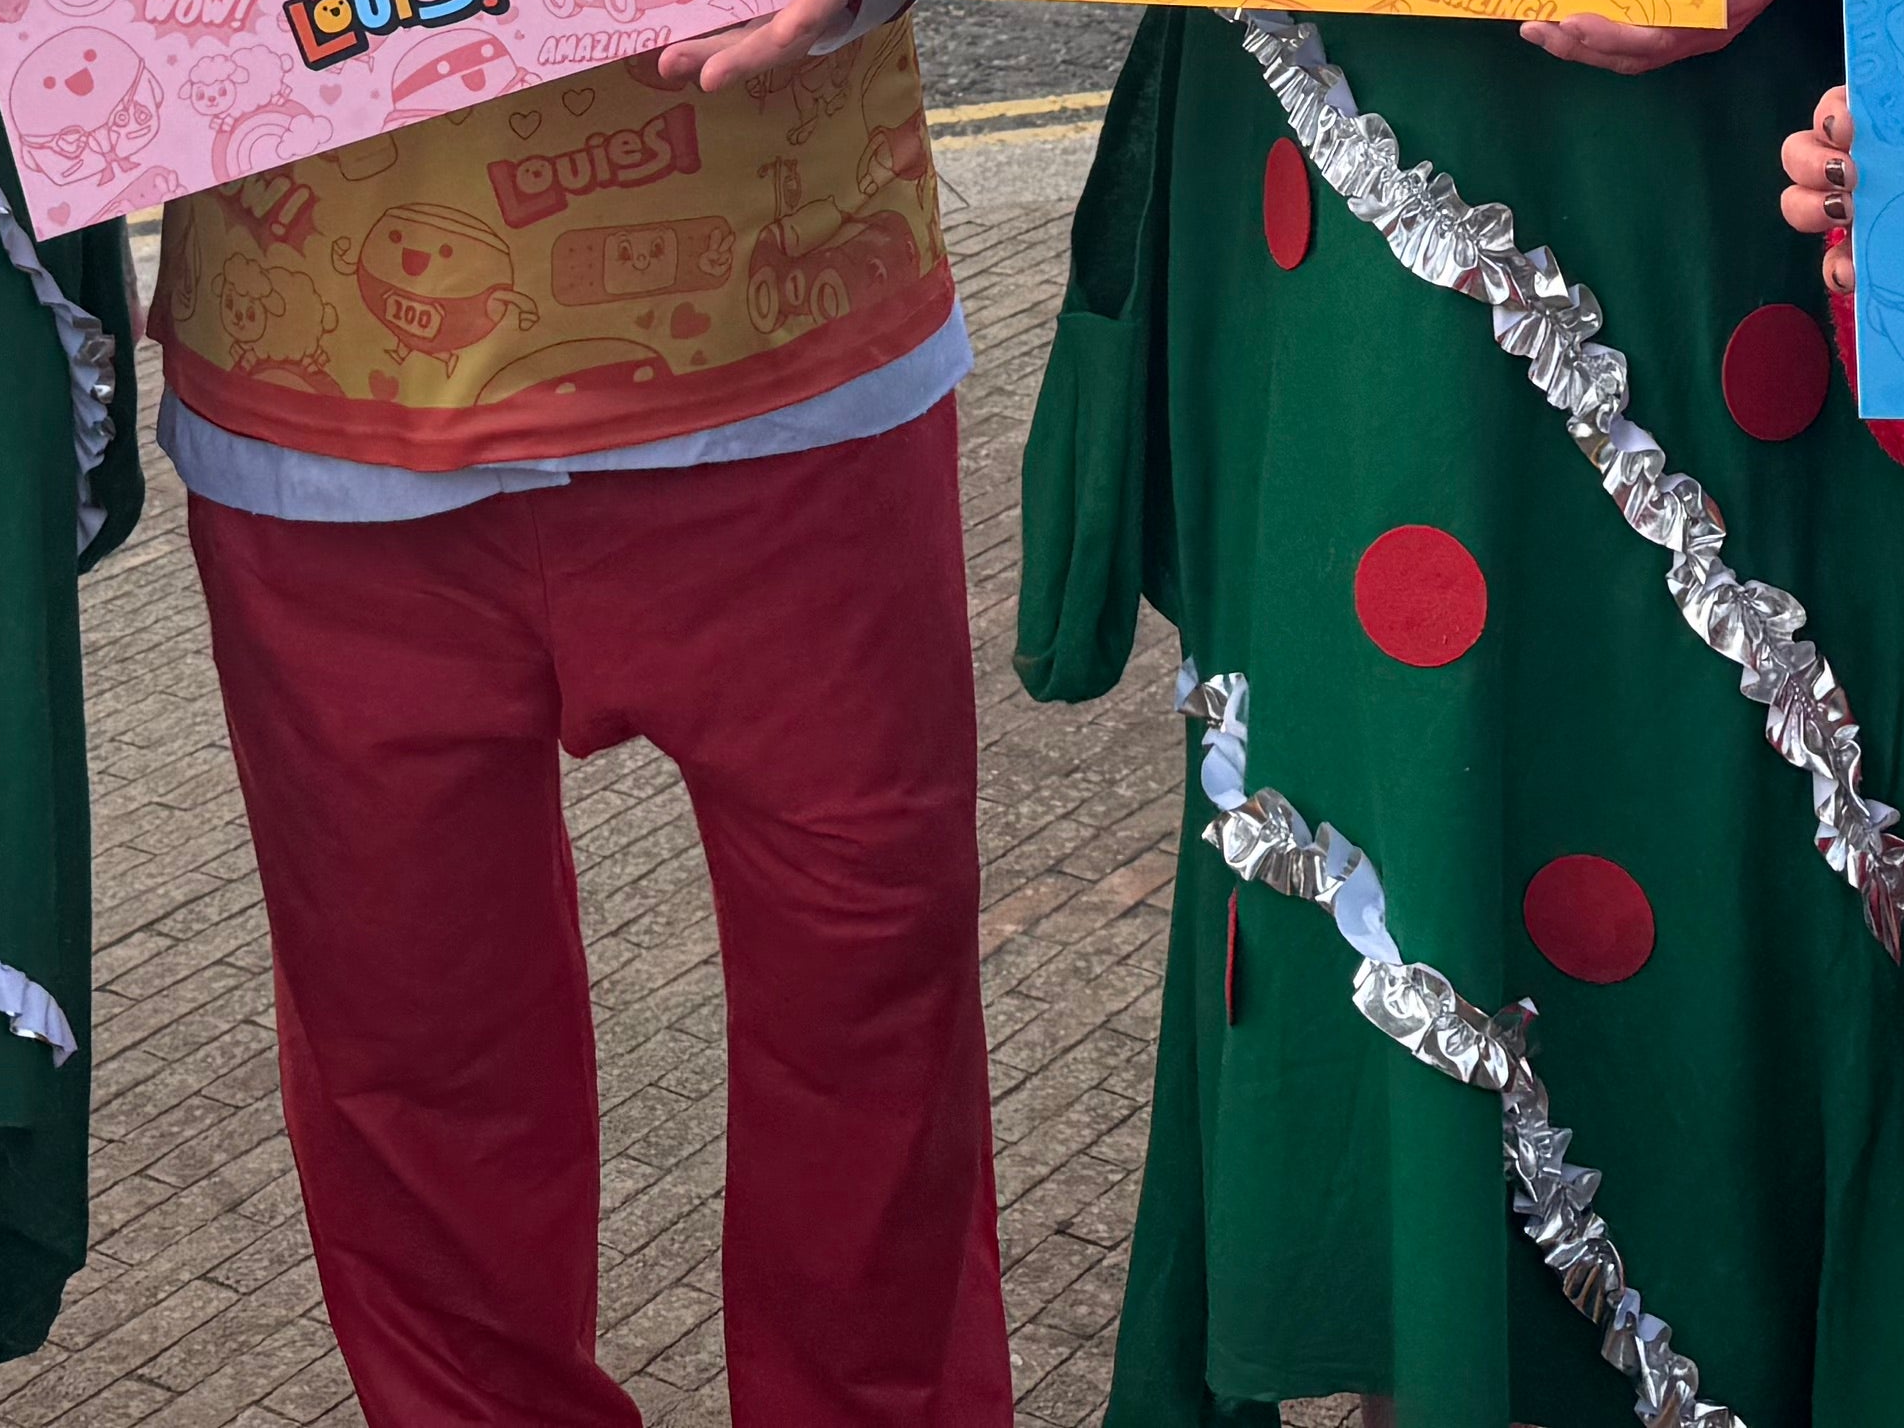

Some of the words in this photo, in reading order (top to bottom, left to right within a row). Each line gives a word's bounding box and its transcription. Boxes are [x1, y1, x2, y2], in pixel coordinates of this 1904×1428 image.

[538, 25, 672, 65] AMAZING!
[487, 102, 701, 229] Louies!
[392, 299, 433, 330] 100
